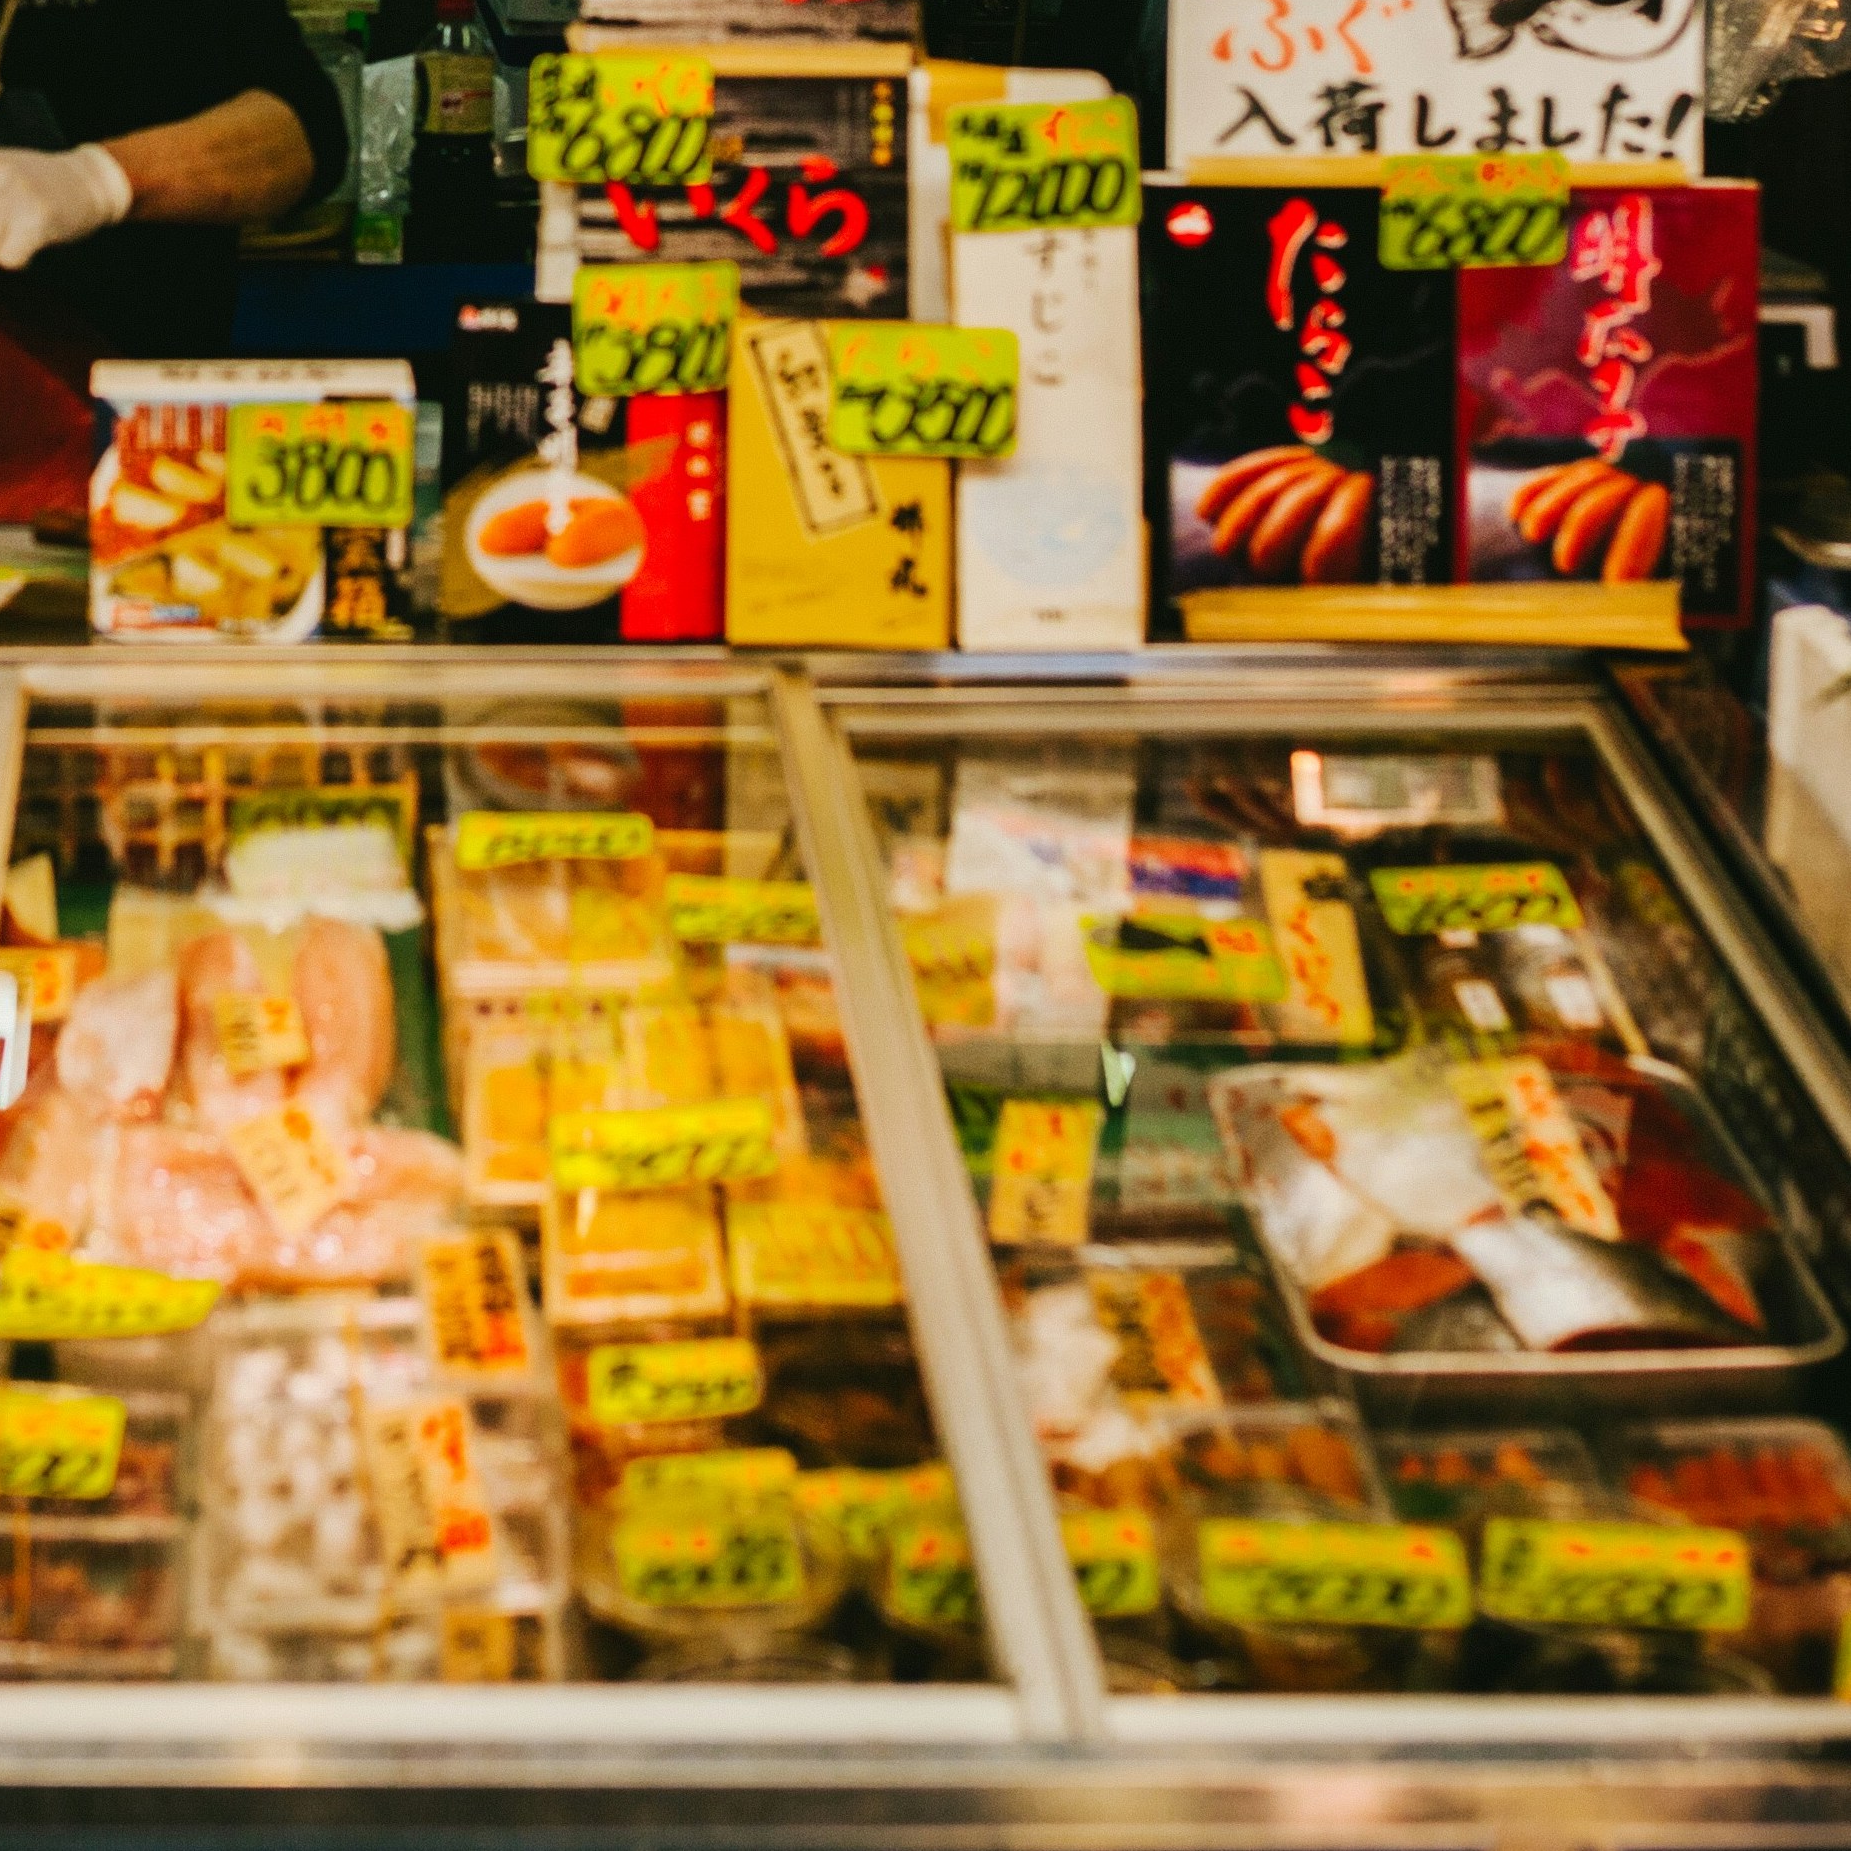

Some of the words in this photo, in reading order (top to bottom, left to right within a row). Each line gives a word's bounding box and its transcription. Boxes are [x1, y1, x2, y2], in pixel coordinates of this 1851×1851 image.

[1217, 80, 1694, 160] 入荷しました!
